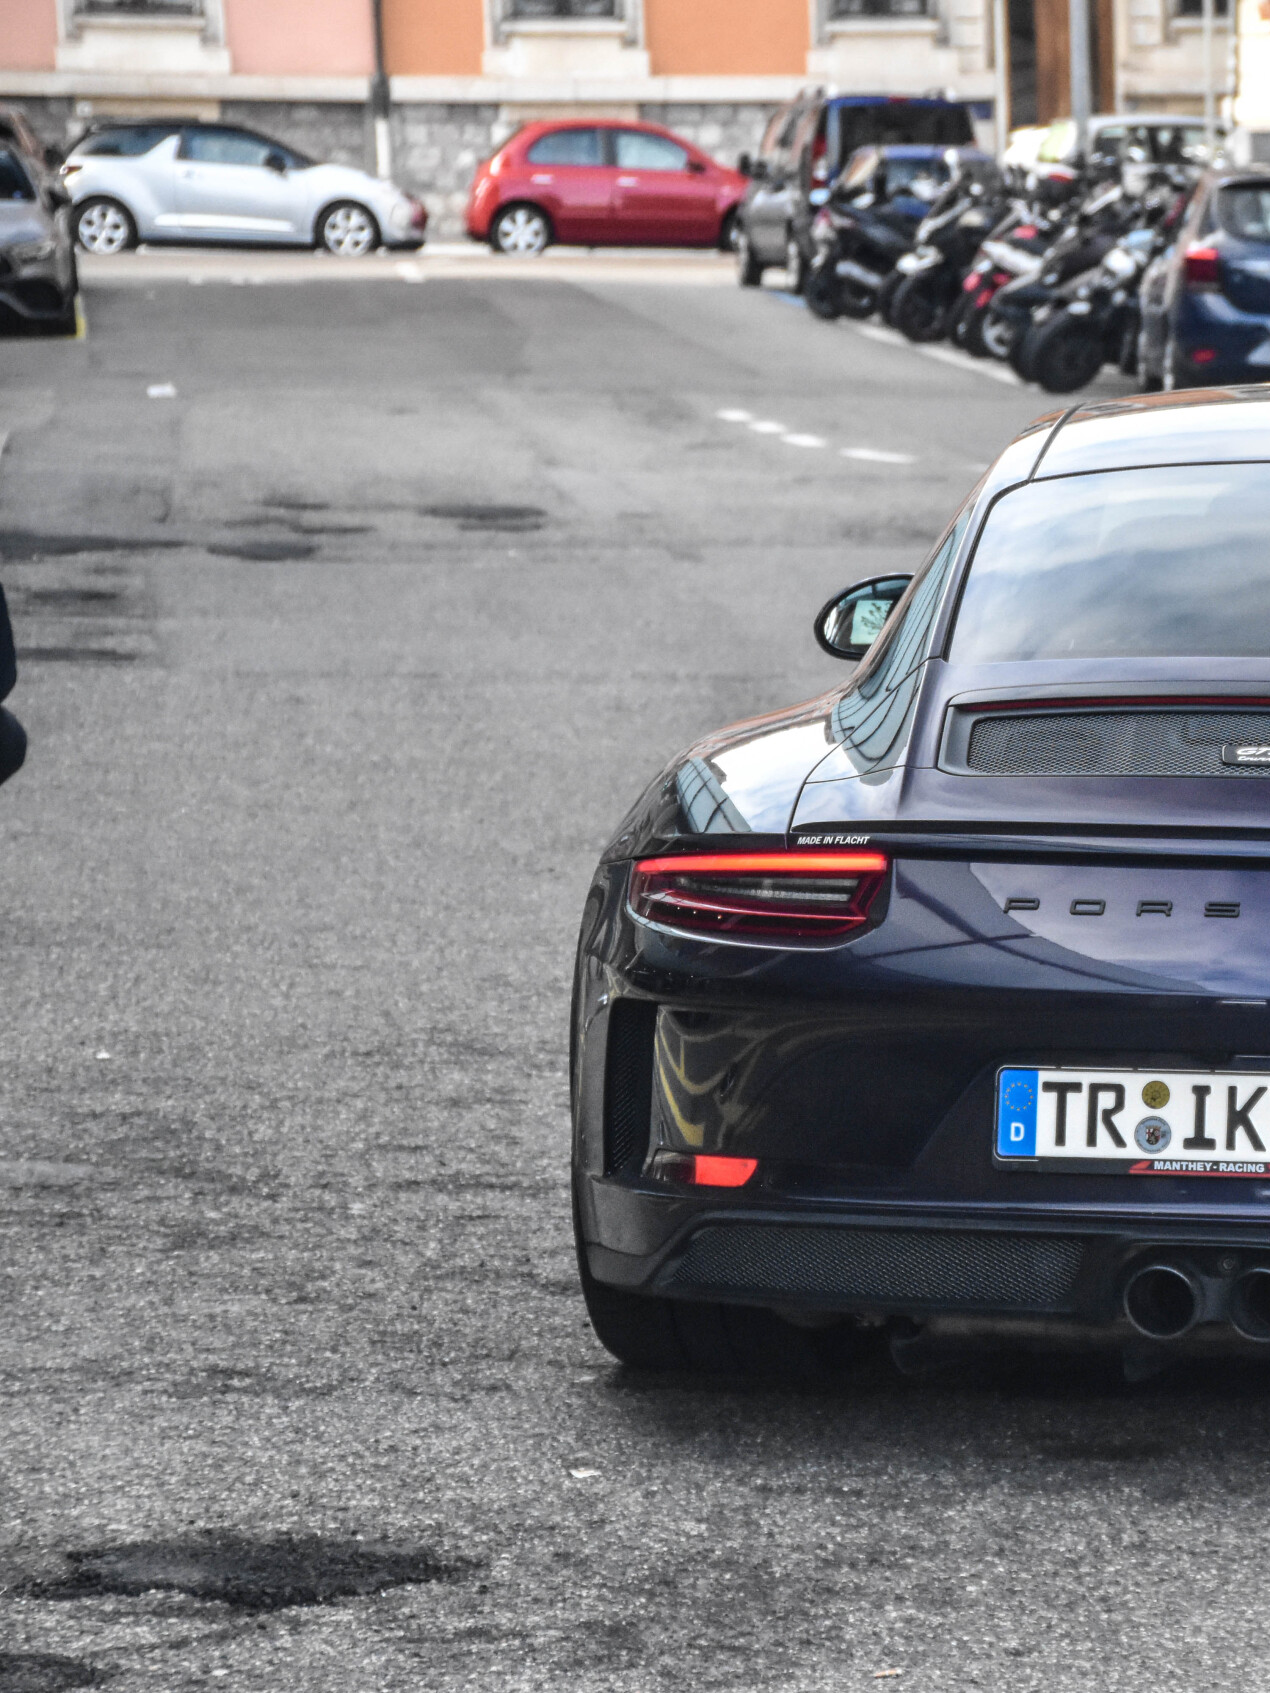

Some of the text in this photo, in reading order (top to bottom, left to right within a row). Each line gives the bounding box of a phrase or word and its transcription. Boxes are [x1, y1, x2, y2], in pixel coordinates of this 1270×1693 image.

[797, 836, 871, 845] MADE IN FLACHT
[1042, 1081, 1127, 1149] TR
[1183, 1085, 1269, 1152] IK
[1010, 1122, 1025, 1141] D
